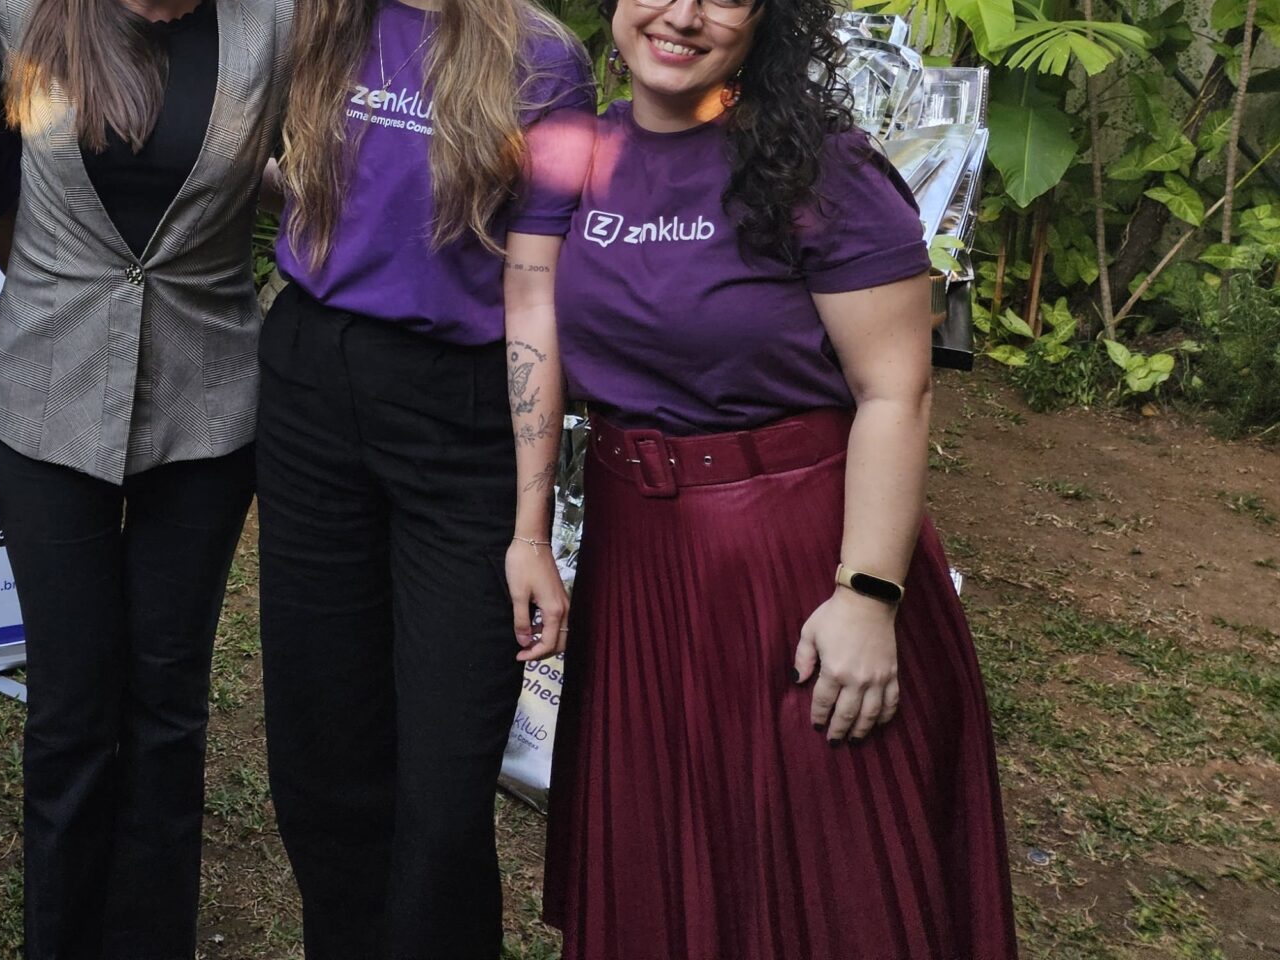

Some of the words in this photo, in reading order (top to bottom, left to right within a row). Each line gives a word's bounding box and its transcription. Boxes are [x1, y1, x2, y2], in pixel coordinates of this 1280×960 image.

[350, 84, 434, 120] zenklu
[346, 108, 369, 121] uma
[370, 115, 406, 128] empresa
[624, 215, 715, 244] znklub
[514, 710, 548, 741] klub
